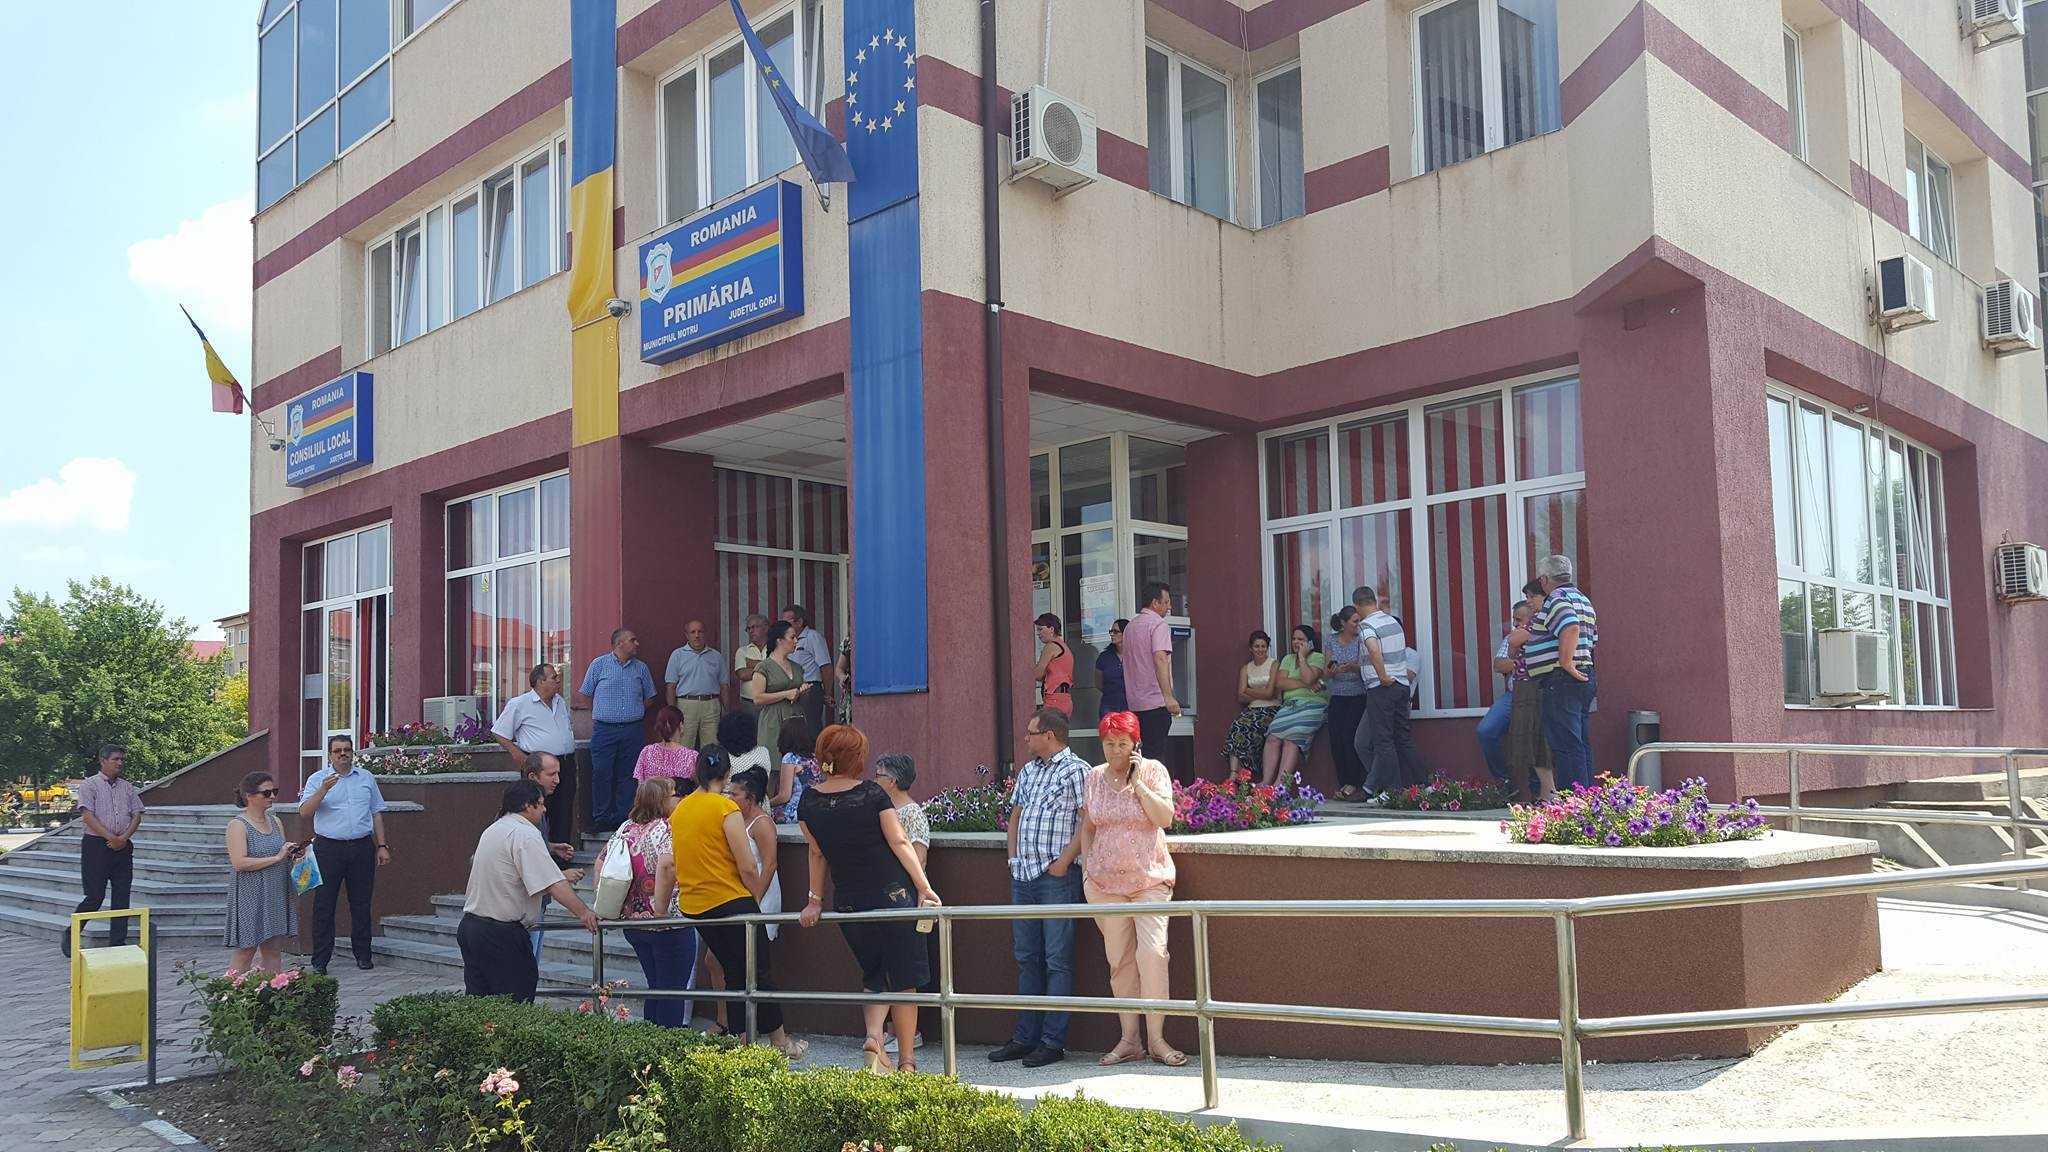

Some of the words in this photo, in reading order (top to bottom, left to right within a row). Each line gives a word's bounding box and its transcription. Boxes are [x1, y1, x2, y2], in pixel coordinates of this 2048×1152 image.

[690, 206, 757, 247] ROMANIA
[663, 276, 753, 328] PRIMĂRIA
[758, 294, 777, 309] GORJ
[643, 333, 677, 352] MUNICIPIUL
[677, 323, 699, 340] MOTRU
[311, 387, 344, 410] ROMANIA
[290, 440, 326, 466] CONSILIUL
[327, 430, 351, 451] LOCAL
